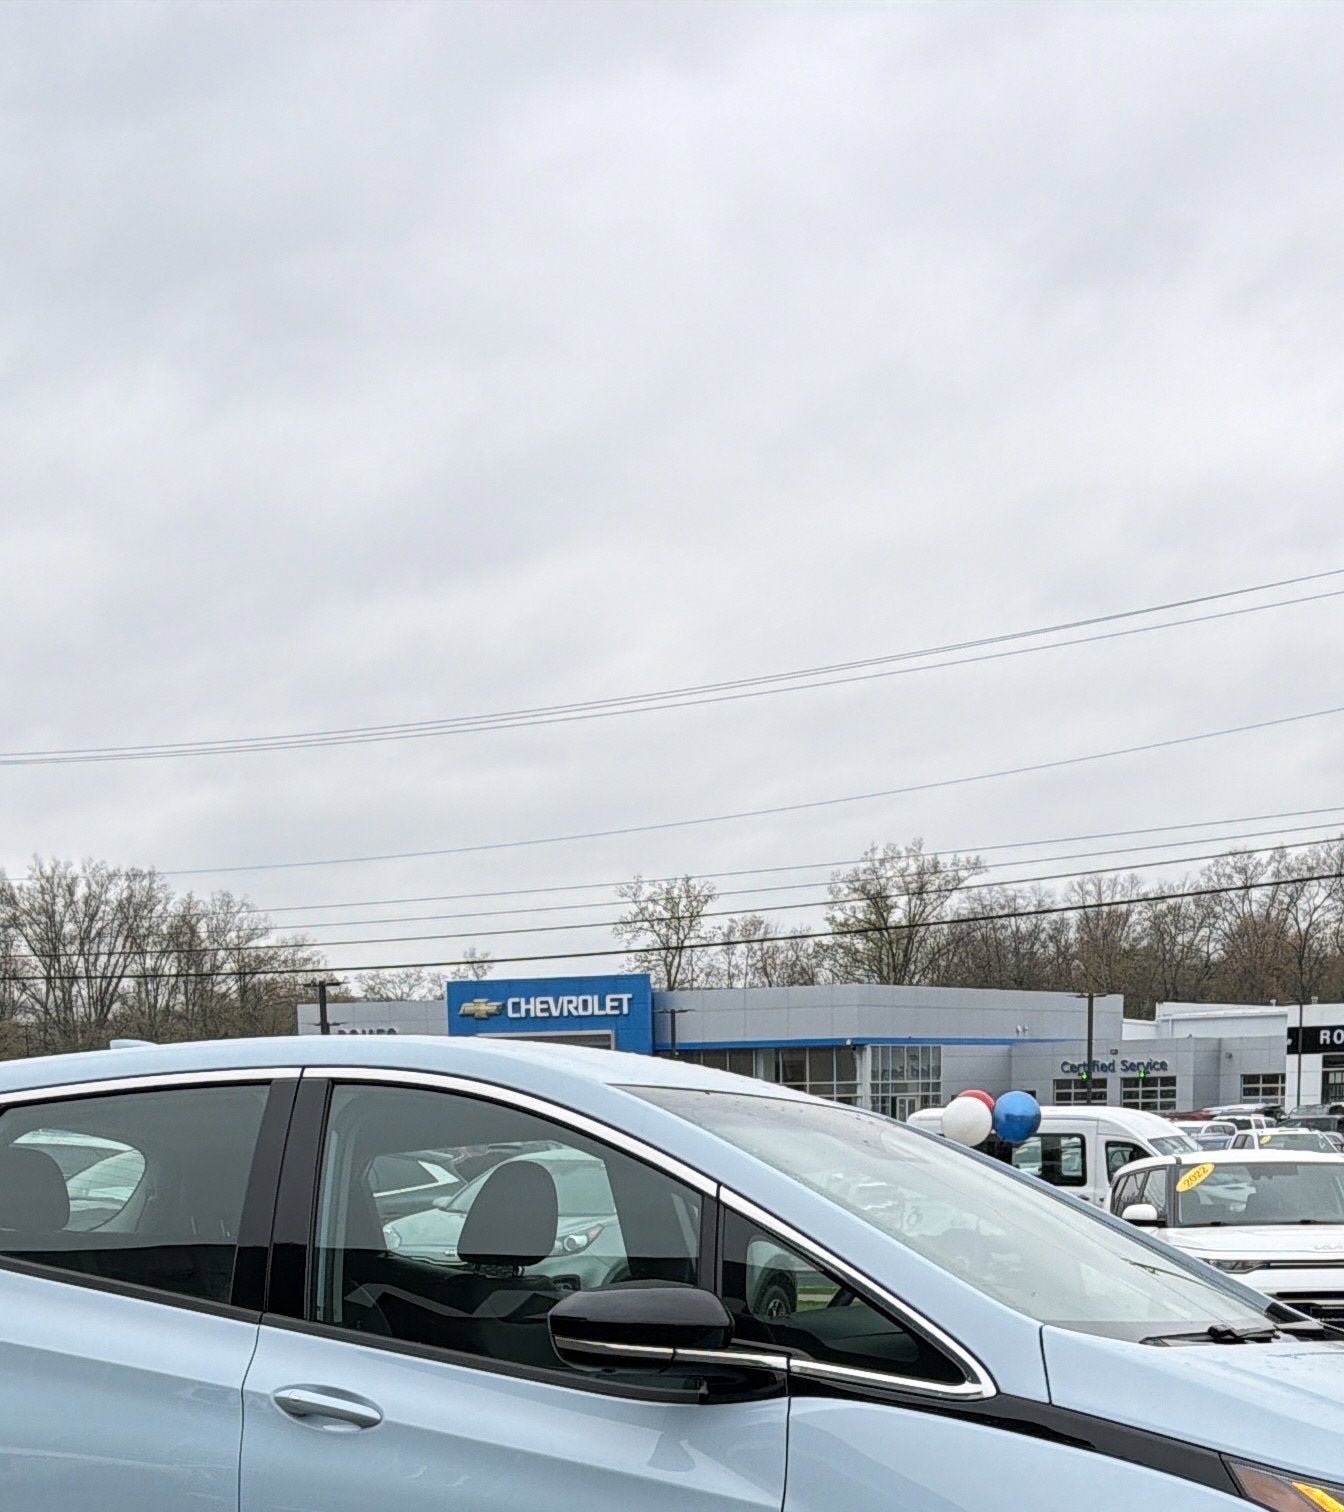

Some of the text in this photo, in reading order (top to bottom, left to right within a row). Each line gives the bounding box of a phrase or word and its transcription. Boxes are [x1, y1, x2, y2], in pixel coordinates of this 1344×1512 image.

[507, 993, 632, 1018] CHEVROLET
[1060, 1058, 1168, 1074] Certfied Service
[1183, 1166, 1209, 1188] 2022
